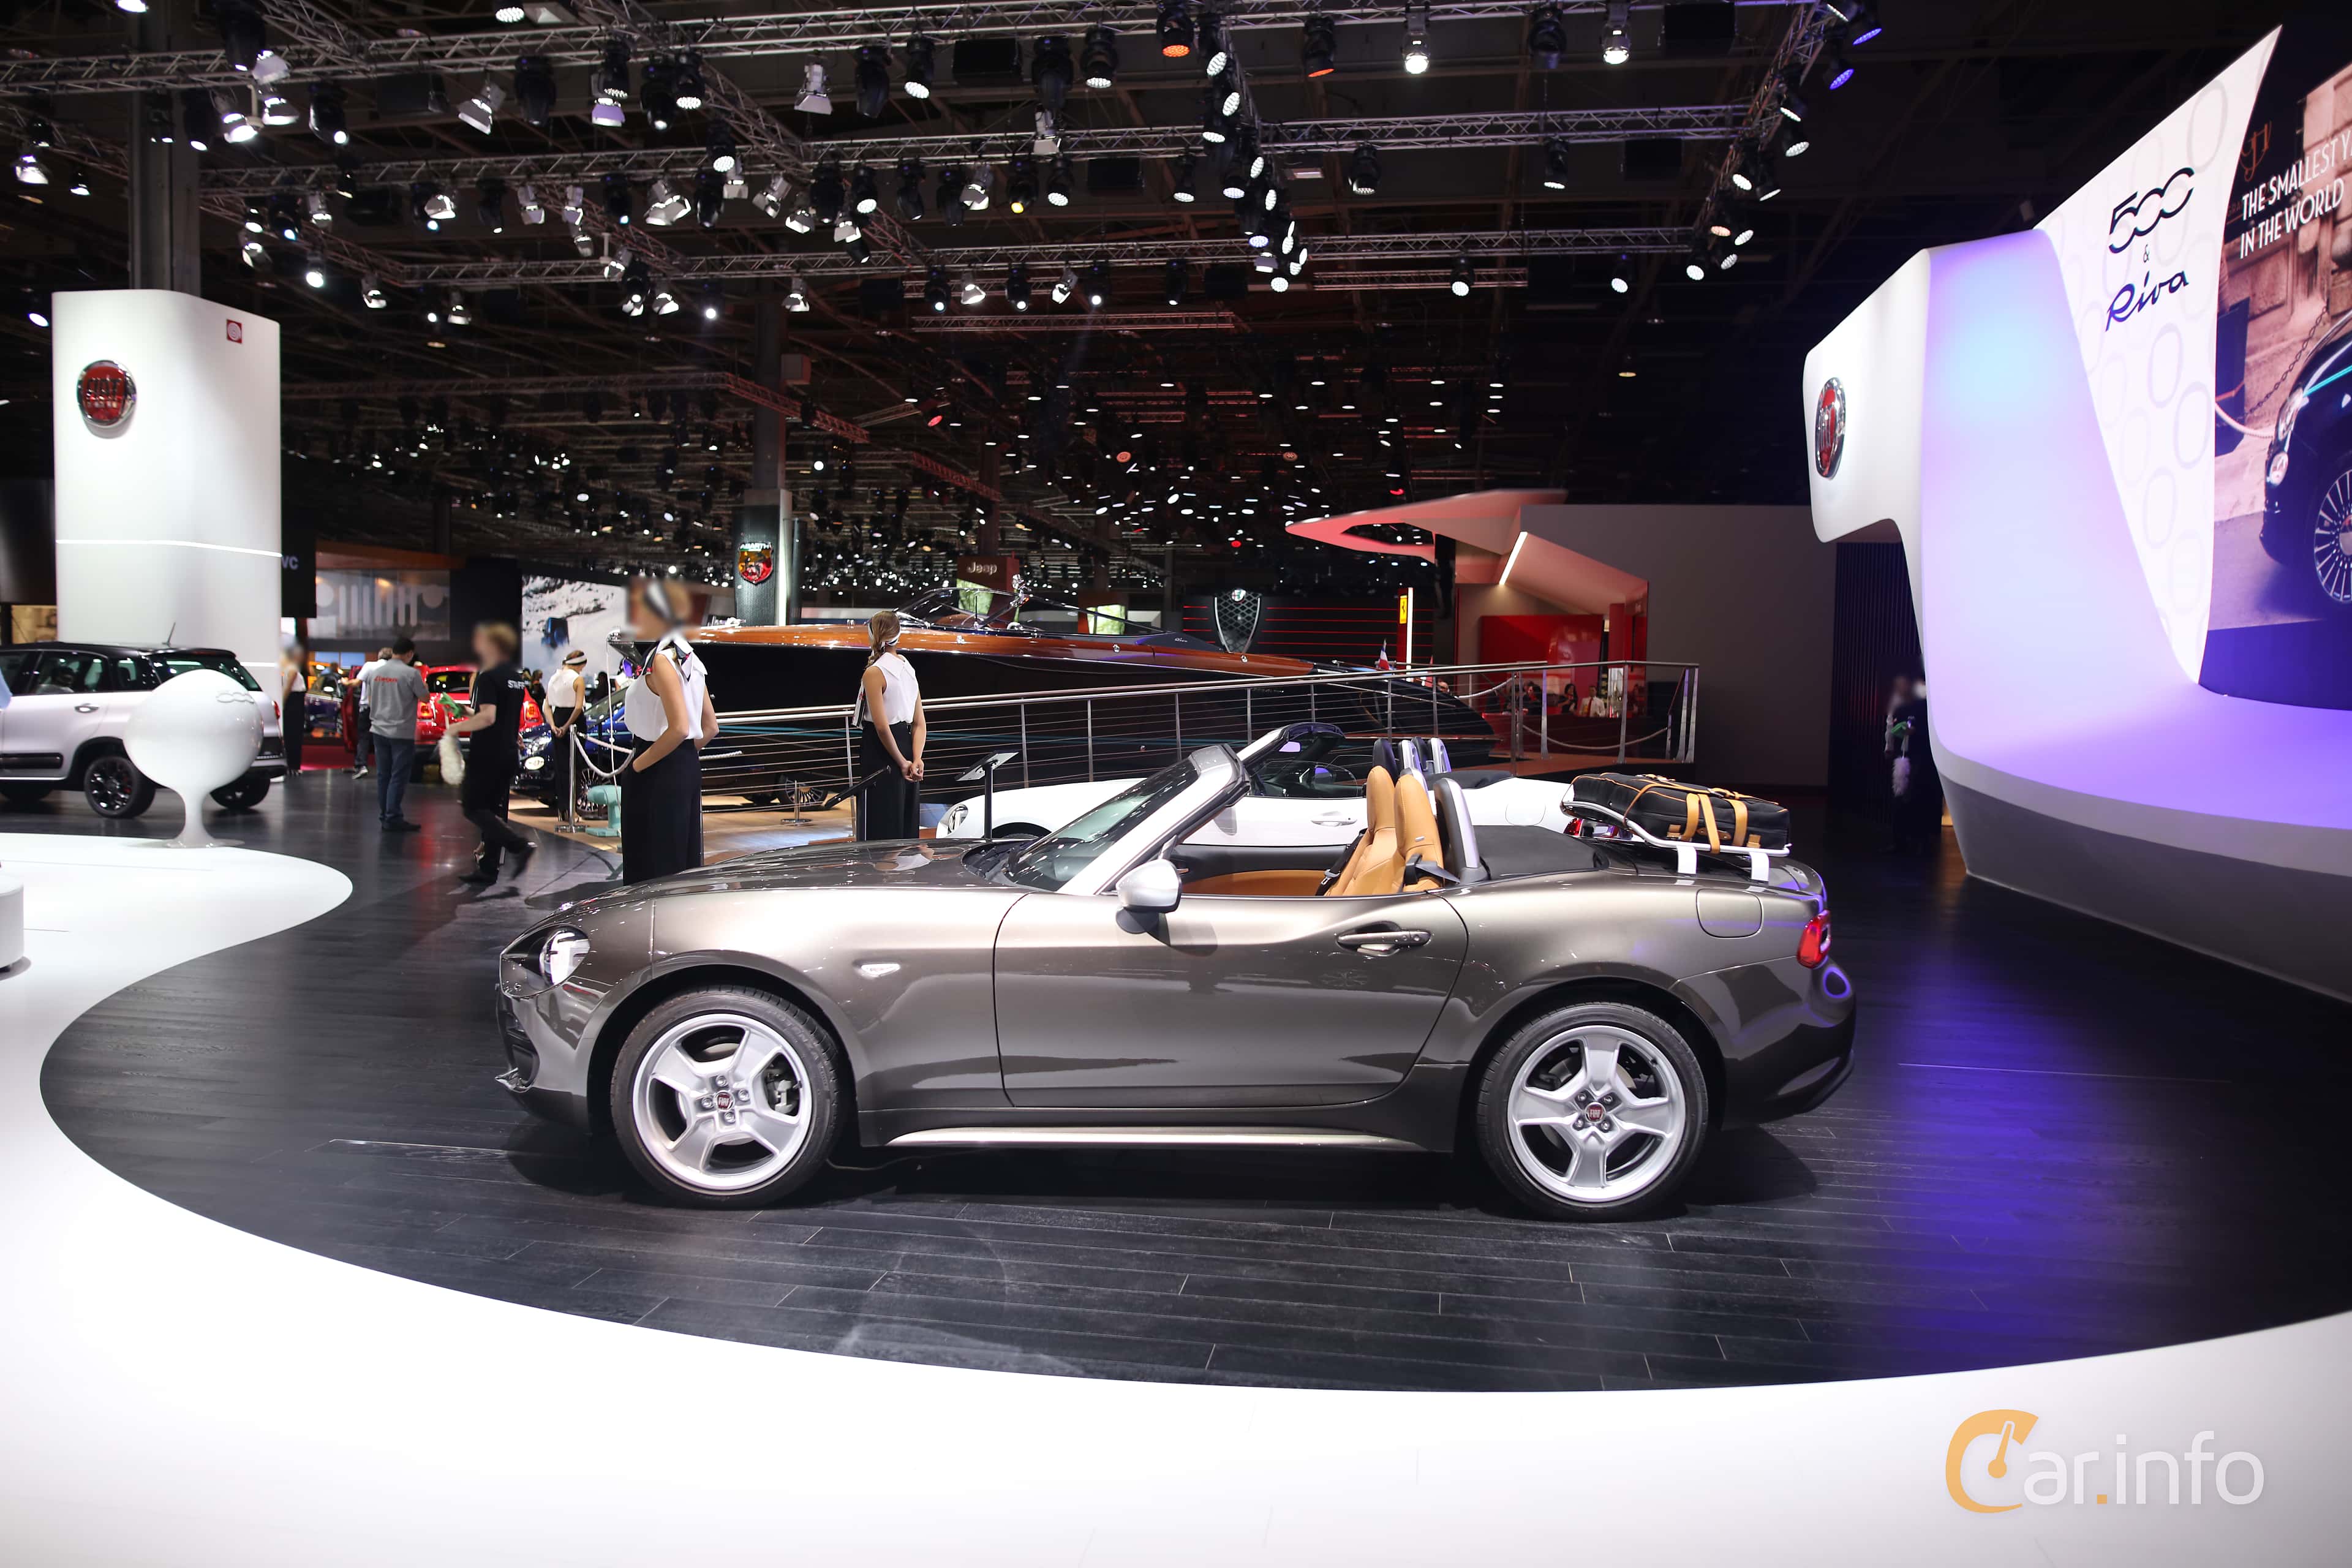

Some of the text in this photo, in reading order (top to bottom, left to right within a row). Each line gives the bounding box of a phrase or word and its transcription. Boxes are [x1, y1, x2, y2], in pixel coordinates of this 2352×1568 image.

[2242, 183, 2266, 221] THE
[2268, 137, 2339, 206] SMALLEST
[2342, 129, 2352, 160] Y
[2109, 167, 2195, 254] 500
[2239, 227, 2255, 260] IN
[2258, 211, 2283, 249] THE
[2285, 178, 2345, 234] WORLD
[2143, 243, 2150, 263] &
[2105, 270, 2190, 333] Riva
[86, 377, 122, 402] FIAT
[967, 562, 998, 576] Jeep
[1589, 1109, 1601, 1118] FIAT
